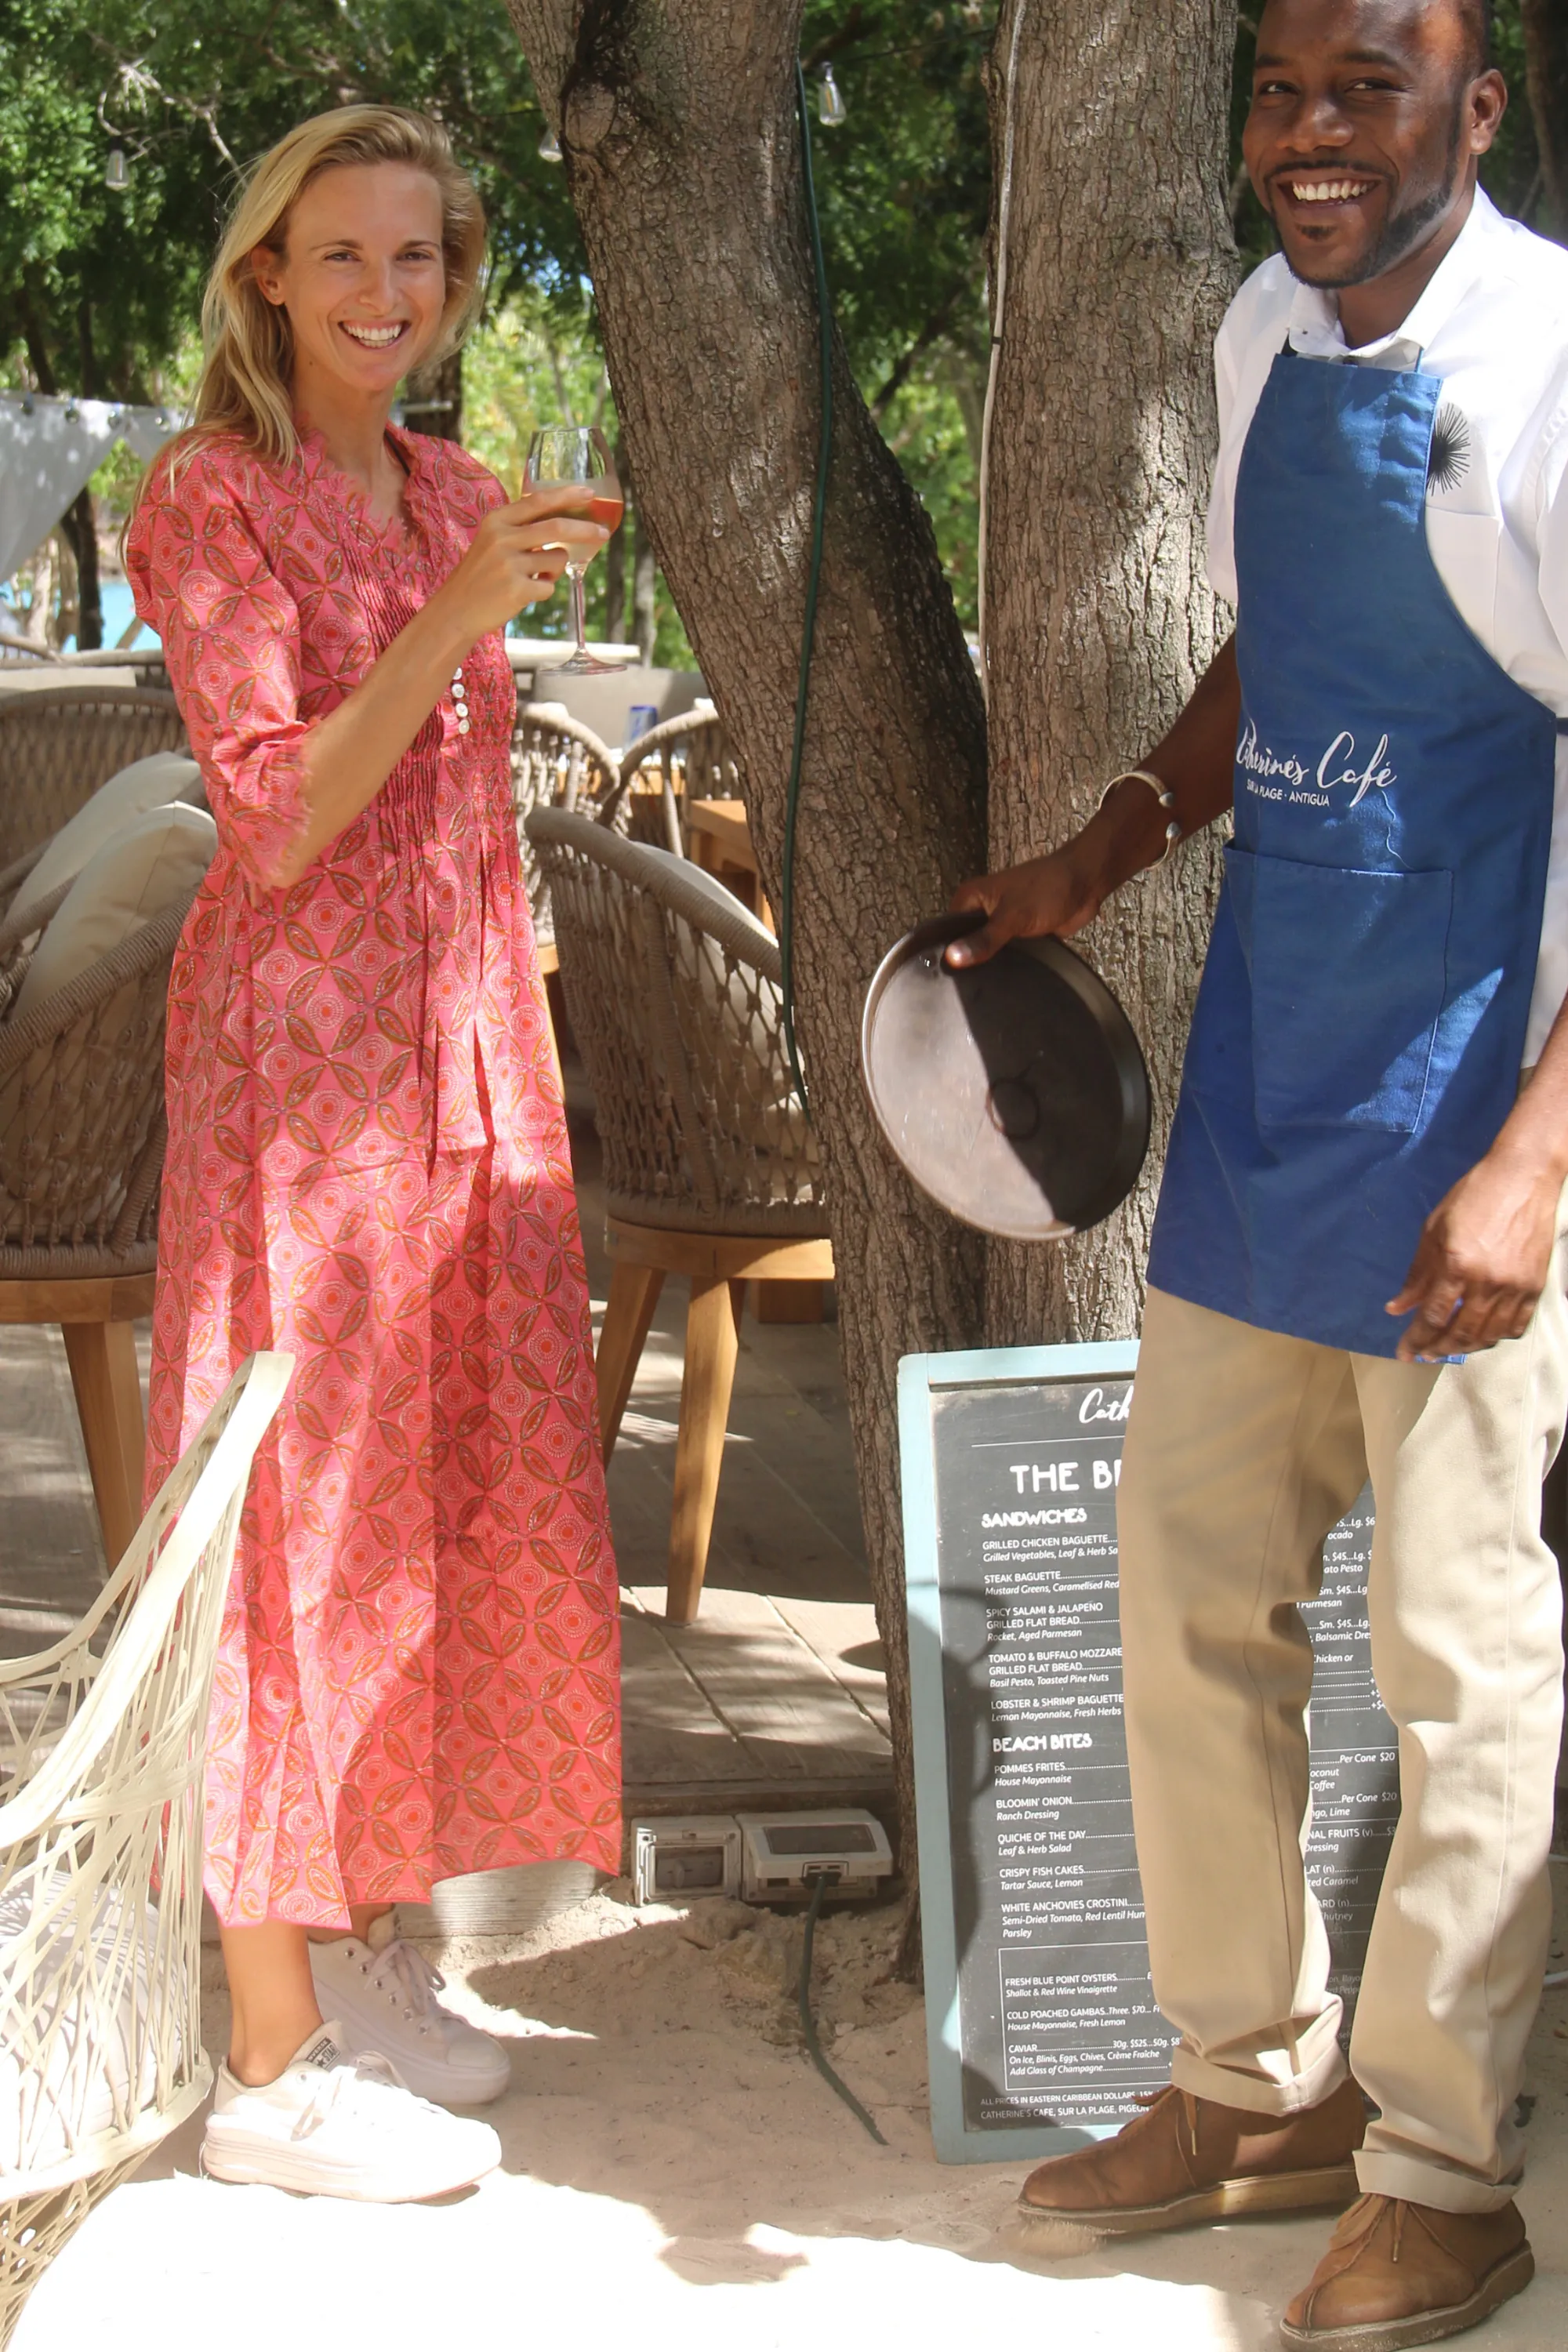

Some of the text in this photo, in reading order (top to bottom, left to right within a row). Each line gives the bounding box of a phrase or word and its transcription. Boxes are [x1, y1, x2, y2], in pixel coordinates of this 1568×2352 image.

[1316, 731, 1397, 808] Café
[1289, 791, 1330, 806] ANTIGUA
[1010, 1462, 1080, 1494] THE
[982, 1507, 1087, 1529] SANDWICHES
[982, 1540, 1019, 1550] GRILLED
[1022, 1537, 1059, 1548] CHICKEN
[983, 1547, 1105, 1562] Grilled Vegetables, Leaf & Herb
[1341, 1564, 1363, 1573] Pesto
[984, 1574, 1012, 1584] STEAK
[985, 1580, 1120, 1595] Mustard Greens, Caramelised Red
[986, 1608, 1010, 1617] SPICY
[1013, 1606, 1046, 1616] SALAMI
[1048, 1606, 1054, 1614] &
[987, 1619, 1024, 1629] GRILLED
[1026, 1617, 1047, 1627] FLAT
[988, 1629, 1082, 1642] Rocket, Aged Parmesan
[1316, 1632, 1352, 1642] Balsamic
[988, 1653, 1025, 1663] TOMATO
[1037, 1650, 1077, 1660] BUFFALO
[989, 1665, 1025, 1675] GRILLED
[1029, 1664, 1049, 1673] FLAT
[990, 1679, 1009, 1687] Basil
[1037, 1675, 1068, 1685] Toasted
[1070, 1675, 1087, 1683] Pine
[1089, 1673, 1109, 1682] Nuts
[991, 1699, 1030, 1709] LOBSTER
[1041, 1697, 1075, 1707] SHRIMP
[1078, 1694, 1123, 1704] BAGUETTE
[992, 1707, 1121, 1722] Lemon Mayonnaise, Fresh Herbs
[993, 1733, 1092, 1752] BEACH BITES
[1340, 1752, 1395, 1763] Per Cone $20
[995, 1764, 1033, 1773] POMMES
[1022, 1775, 1072, 1786] Mayonnaise
[1341, 1791, 1396, 1803] Per Cone $20
[997, 1810, 1059, 1820] Ranch Dressing
[1330, 1807, 1350, 1817] Lime
[998, 1833, 1032, 1845] QUICHE
[1034, 1832, 1047, 1841] OF
[1049, 1831, 1066, 1840] THE
[1328, 1828, 1359, 1838] FRUITS
[998, 1847, 1017, 1857] Leaf
[1049, 1843, 1072, 1853] Salad
[1000, 1868, 1030, 1878] CRISPY
[1033, 1867, 1052, 1875] FISH
[1001, 1879, 1083, 1890] Tartar Sauce, Lemon
[1323, 1875, 1359, 1886] Caramel
[1001, 1903, 1030, 1912] WHITE
[1033, 1900, 1084, 1911] ANCHOVIES
[1003, 1915, 1047, 1926] Semi-Dried
[1050, 1914, 1083, 1923] Tomato,
[1103, 1911, 1125, 1920] Lentil
[1003, 1929, 1032, 1938] Parsley
[1033, 1976, 1054, 1985] BLUE
[1006, 1989, 1031, 1998] Shallot
[1077, 1985, 1117, 1994] Vinaigrette
[1030, 2009, 1069, 2018] POACHED
[1033, 2020, 1077, 2031] Mayonnaise,
[1080, 2019, 1098, 2027] Fresh
[1010, 2056, 1022, 2064] On
[1022, 2055, 1034, 2064] Ice,
[1036, 2054, 1058, 2063] Blinis,
[1059, 2054, 1078, 2063] Eggs,
[1080, 2053, 1105, 2061] Chives,
[1108, 2050, 1131, 2060] Crème
[1049, 2065, 1058, 2075] of
[1029, 2094, 1060, 2103] EASTERN
[1062, 2092, 1102, 2102] CARIBBEAN
[981, 2108, 1031, 2118] CATHERINE'S
[1058, 2107, 1073, 2115] SUR
[1076, 2106, 1087, 2114] LA
[1089, 2105, 1116, 2114] PLAGE,
